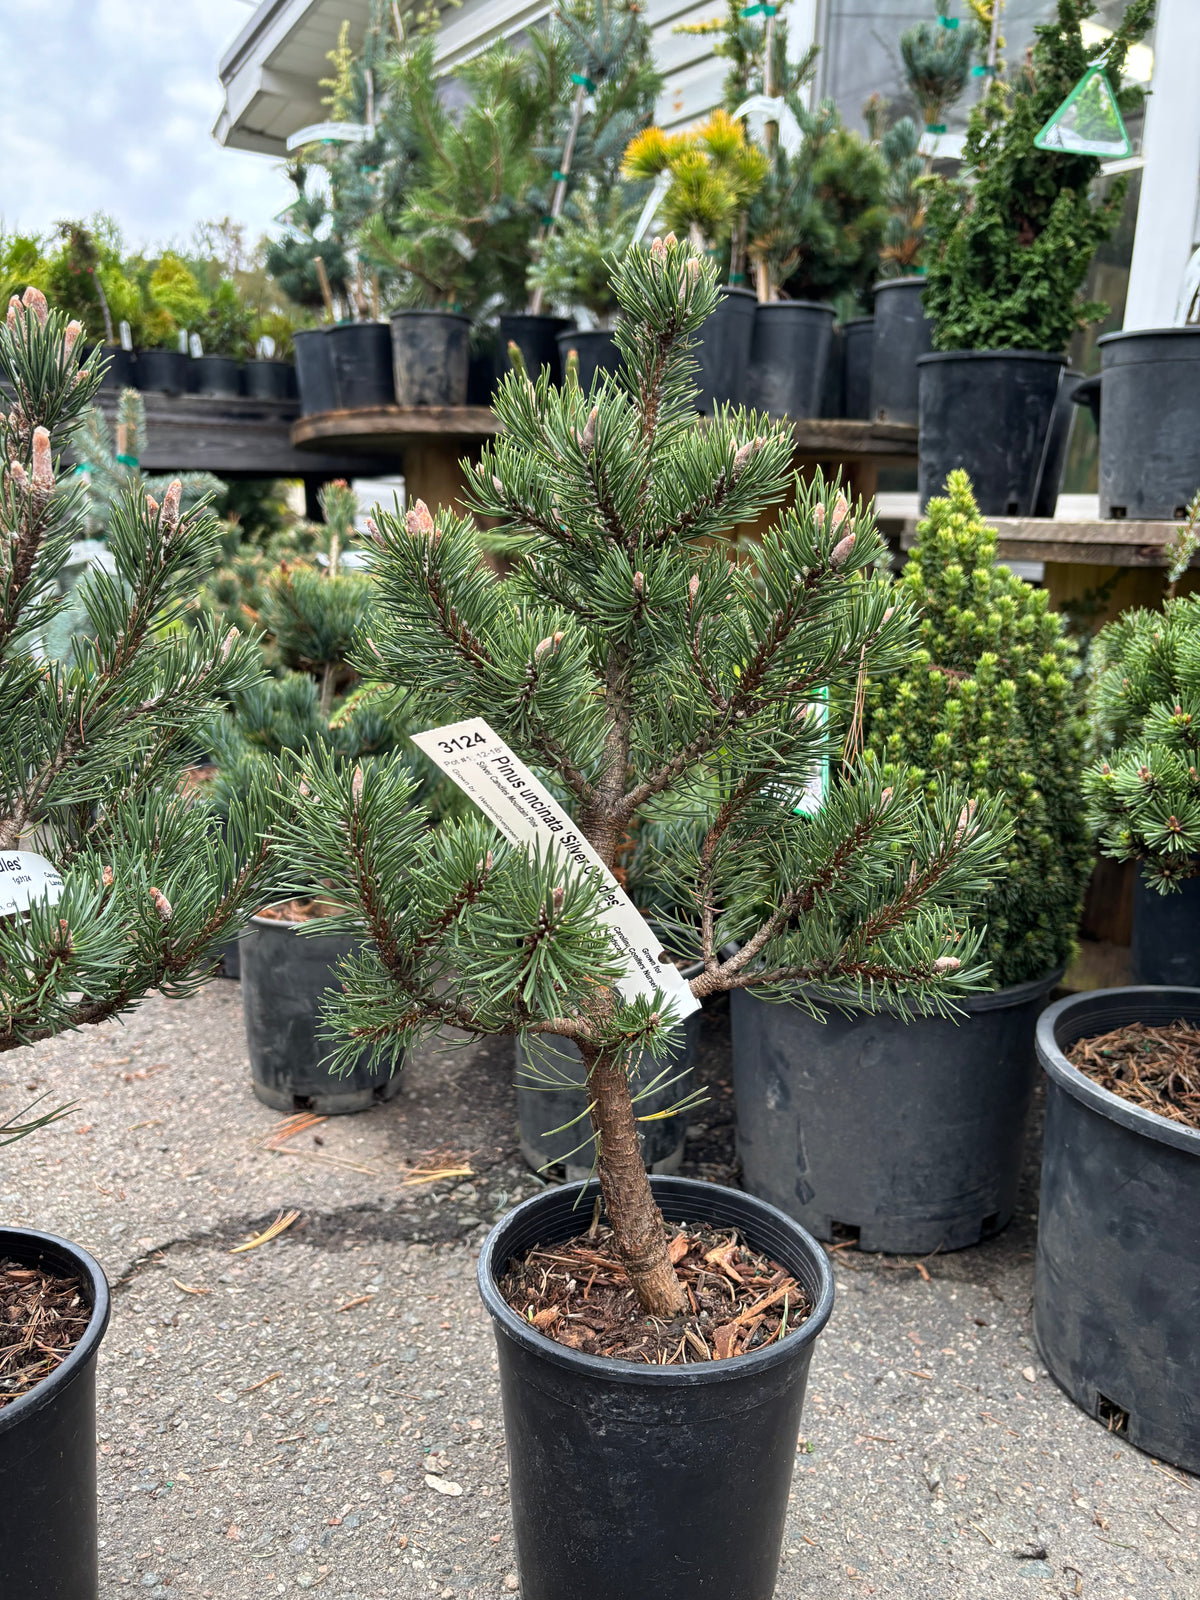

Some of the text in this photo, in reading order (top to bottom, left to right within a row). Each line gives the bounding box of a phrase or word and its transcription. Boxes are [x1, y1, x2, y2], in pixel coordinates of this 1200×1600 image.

[437, 732, 487, 754] 3124
[452, 768, 470, 786] Grown
[468, 784, 477, 793] by
[476, 760, 539, 828] Silver Candles Mountain Pine
[490, 755, 525, 788] Pinus
[520, 789, 563, 832] uncinata
[560, 831, 590, 864] 'Silver
[628, 947, 646, 970] Conifers
[641, 947, 662, 975] Grown for
